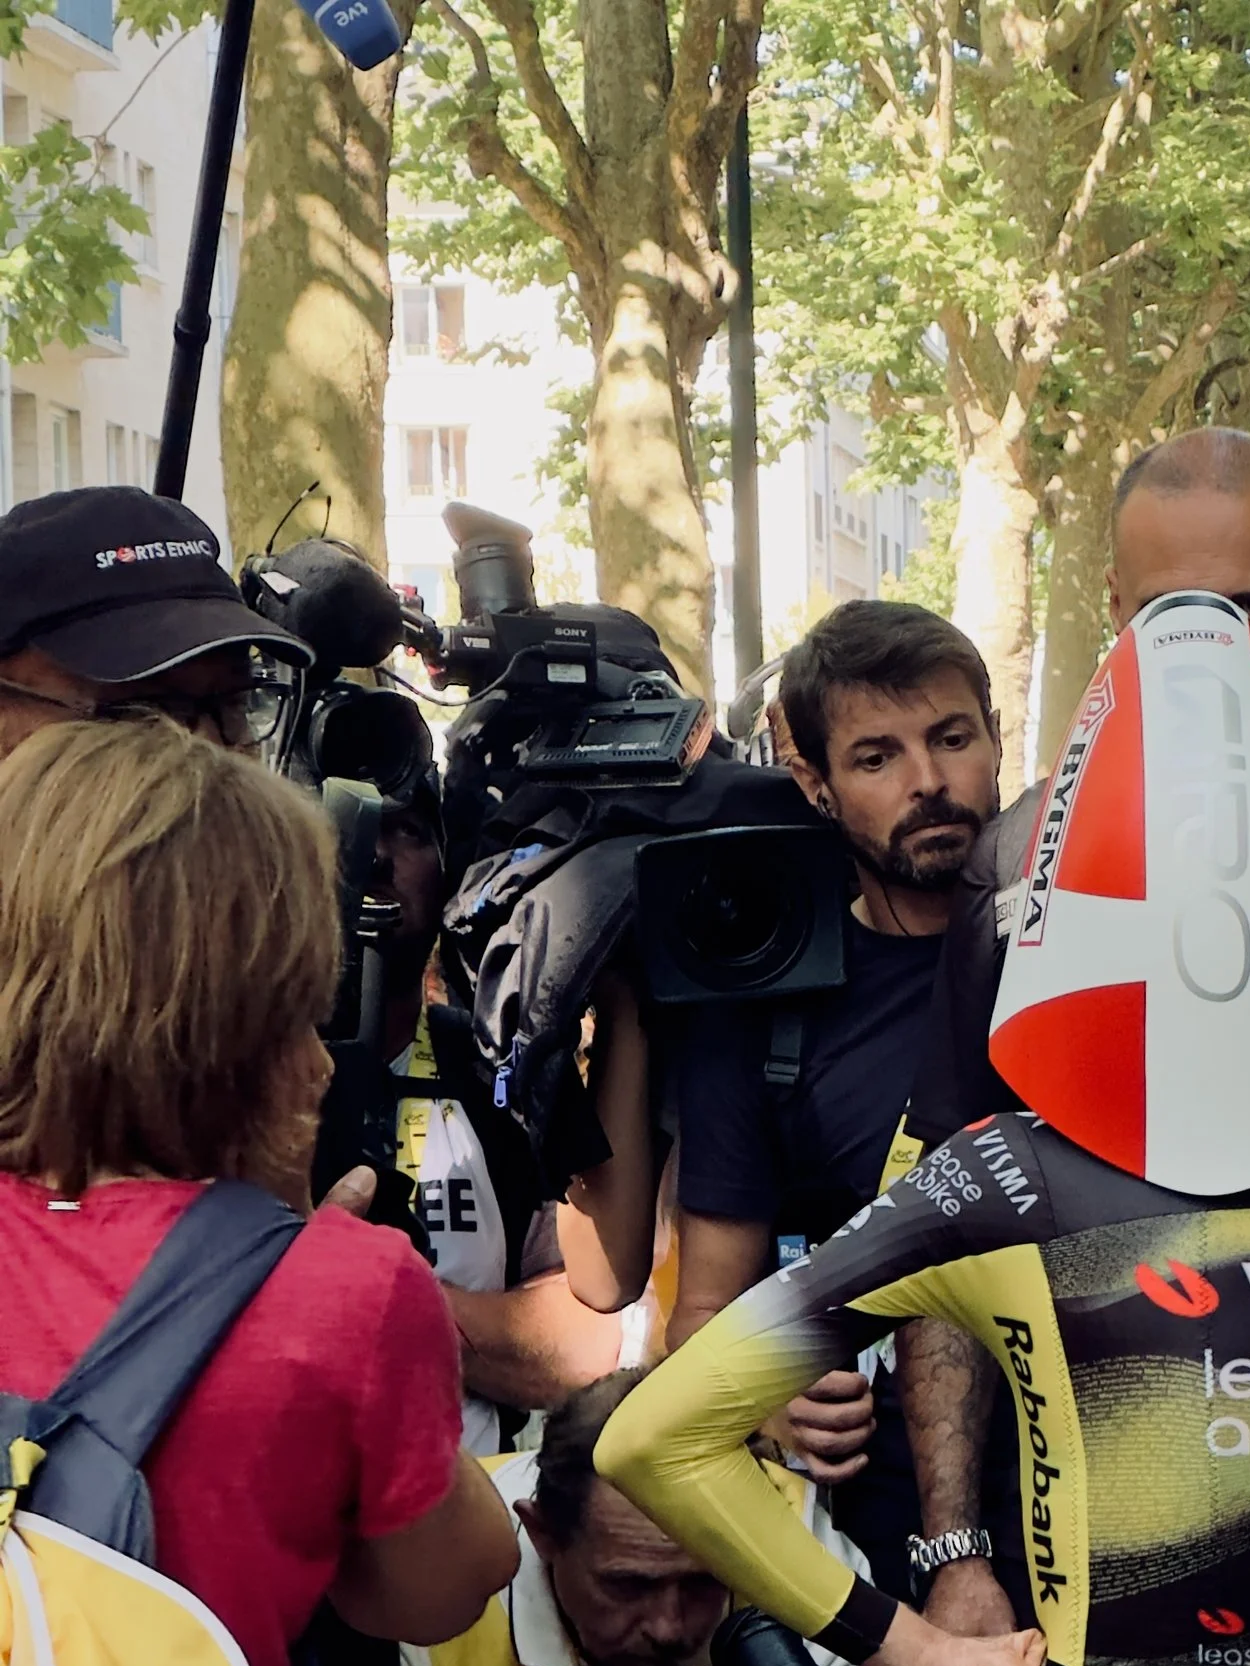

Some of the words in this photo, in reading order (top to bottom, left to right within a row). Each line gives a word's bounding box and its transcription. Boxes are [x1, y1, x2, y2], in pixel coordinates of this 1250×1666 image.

[333, 1, 369, 27] tve
[554, 627, 588, 637] SONY
[1024, 742, 1087, 933] BYGMA
[927, 1141, 983, 1203] lease
[972, 1128, 1039, 1216] VISMA
[780, 1243, 805, 1259] Rai
[992, 1314, 1068, 1605] Rabobank
